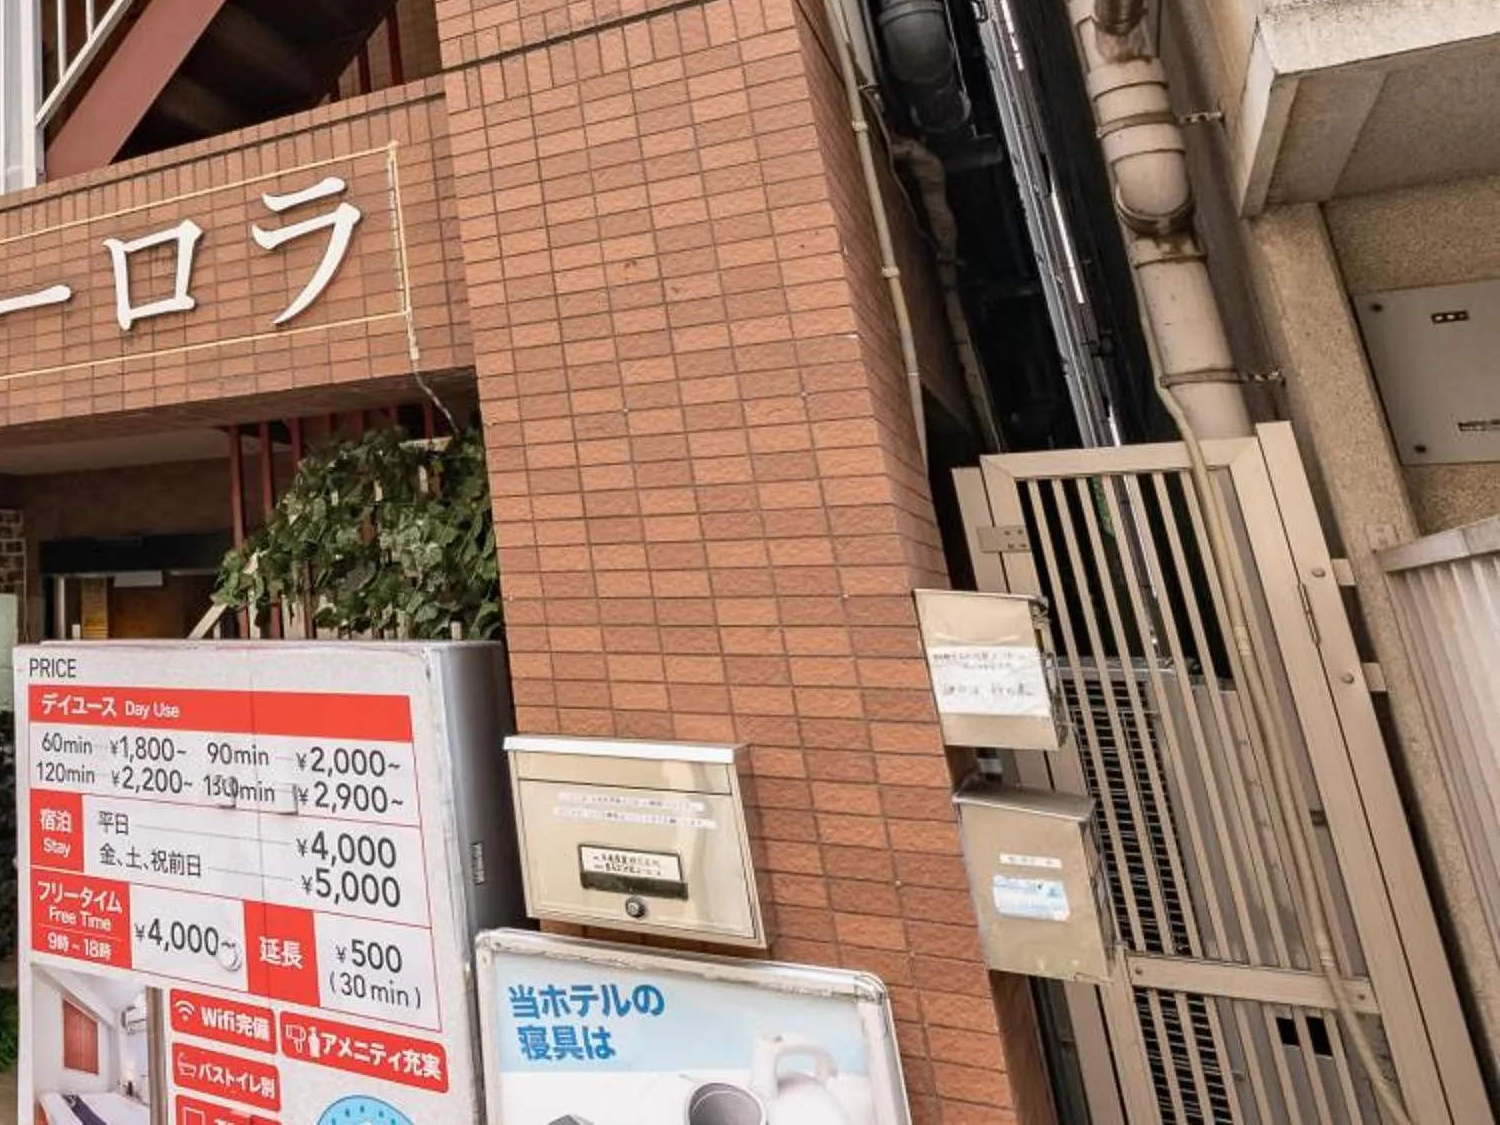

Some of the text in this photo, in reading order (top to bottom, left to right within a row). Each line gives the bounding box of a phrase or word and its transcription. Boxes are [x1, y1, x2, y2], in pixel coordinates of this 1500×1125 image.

[29, 658, 77, 679] PRICE
[41, 692, 180, 719] デイユース Day Use
[41, 732, 93, 755] 60min
[206, 742, 269, 766] 90min
[36, 761, 95, 784] 120min
[39, 808, 72, 833] 宿泊
[43, 837, 71, 858] Stay
[98, 810, 396, 868] 平日 ¥4,000
[37, 880, 123, 913] フリータイム
[301, 867, 400, 908] ¥5,000
[49, 905, 111, 932] Free Time
[258, 935, 303, 969] 延長
[335, 938, 402, 974] ¥500
[508, 983, 666, 1020] 当ホテルの
[319, 1031, 441, 1081] アメニティ充実
[516, 1024, 617, 1061] 寝具は
